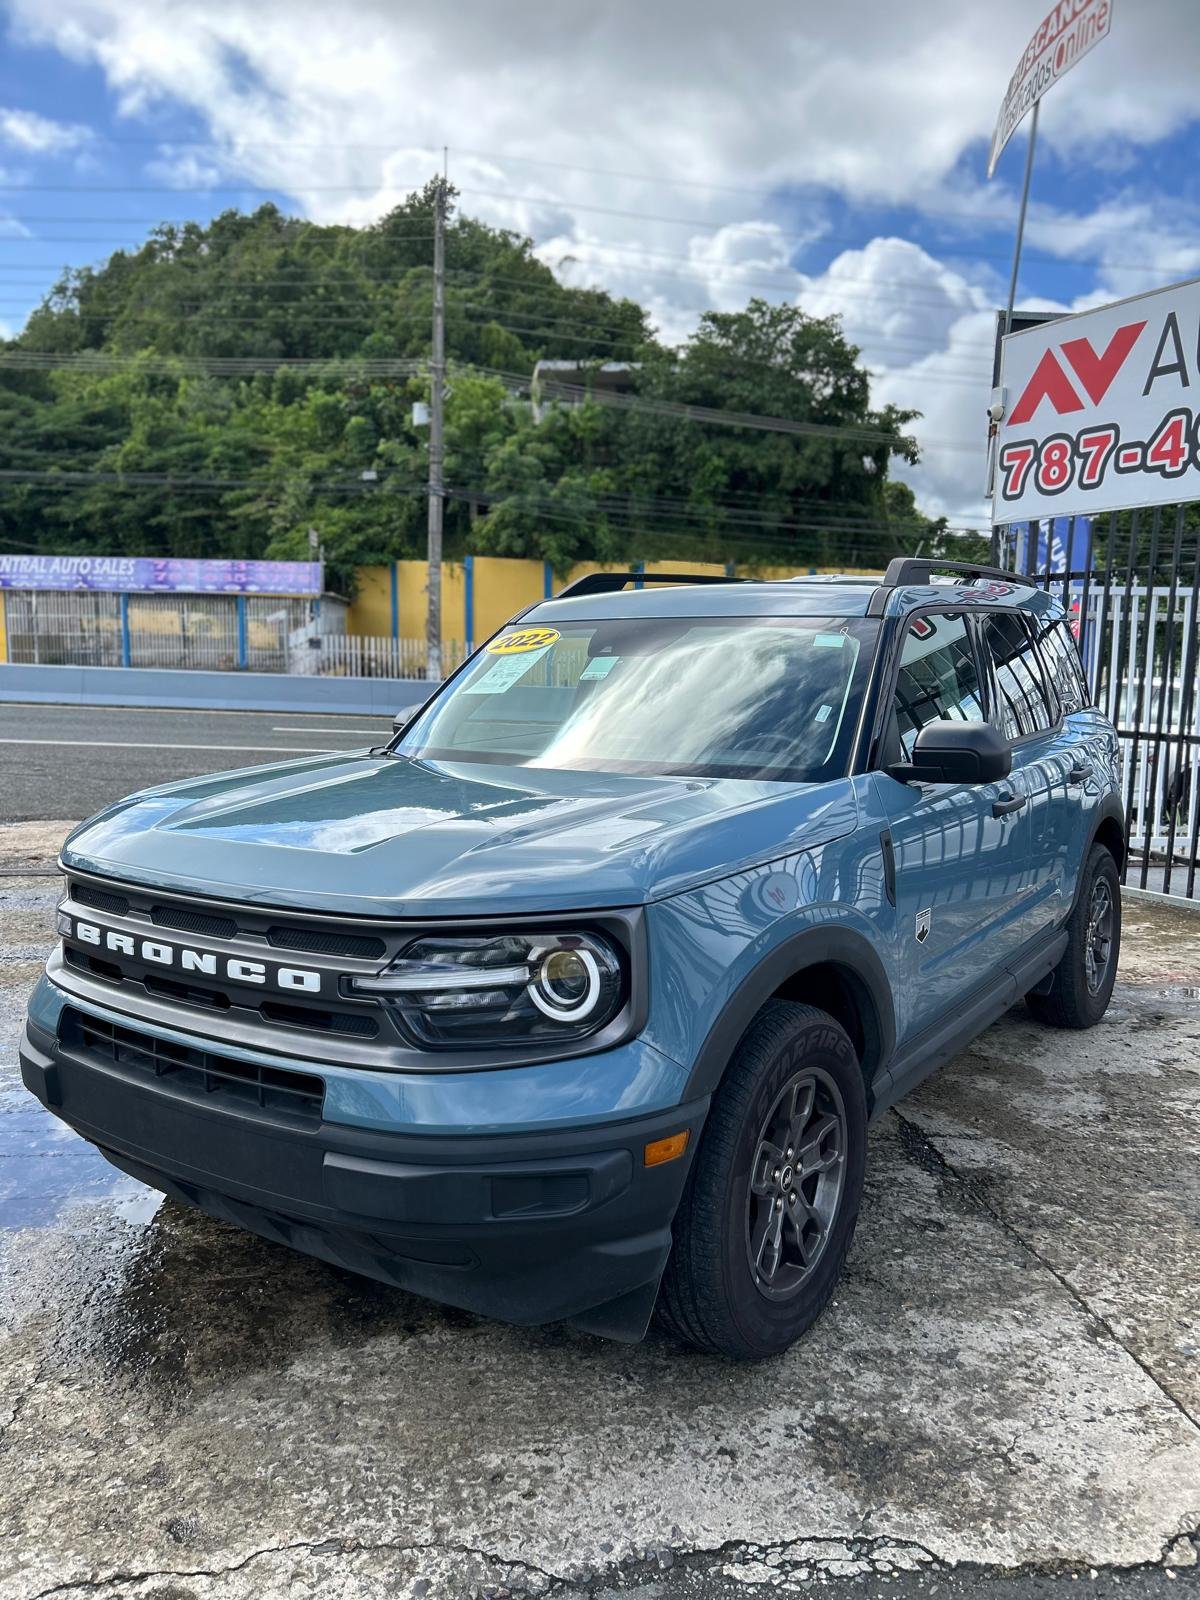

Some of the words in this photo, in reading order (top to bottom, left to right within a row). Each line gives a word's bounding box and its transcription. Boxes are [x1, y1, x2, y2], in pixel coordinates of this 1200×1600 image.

[1006, 320, 1148, 426] AV
[1142, 311, 1200, 397] A
[1000, 408, 1200, 500] 787-4
[0, 556, 47, 573] NTRAL
[50, 557, 91, 574] AUTO
[92, 559, 136, 575] SALES
[489, 632, 556, 650] 2022
[77, 922, 320, 992] BRONCO
